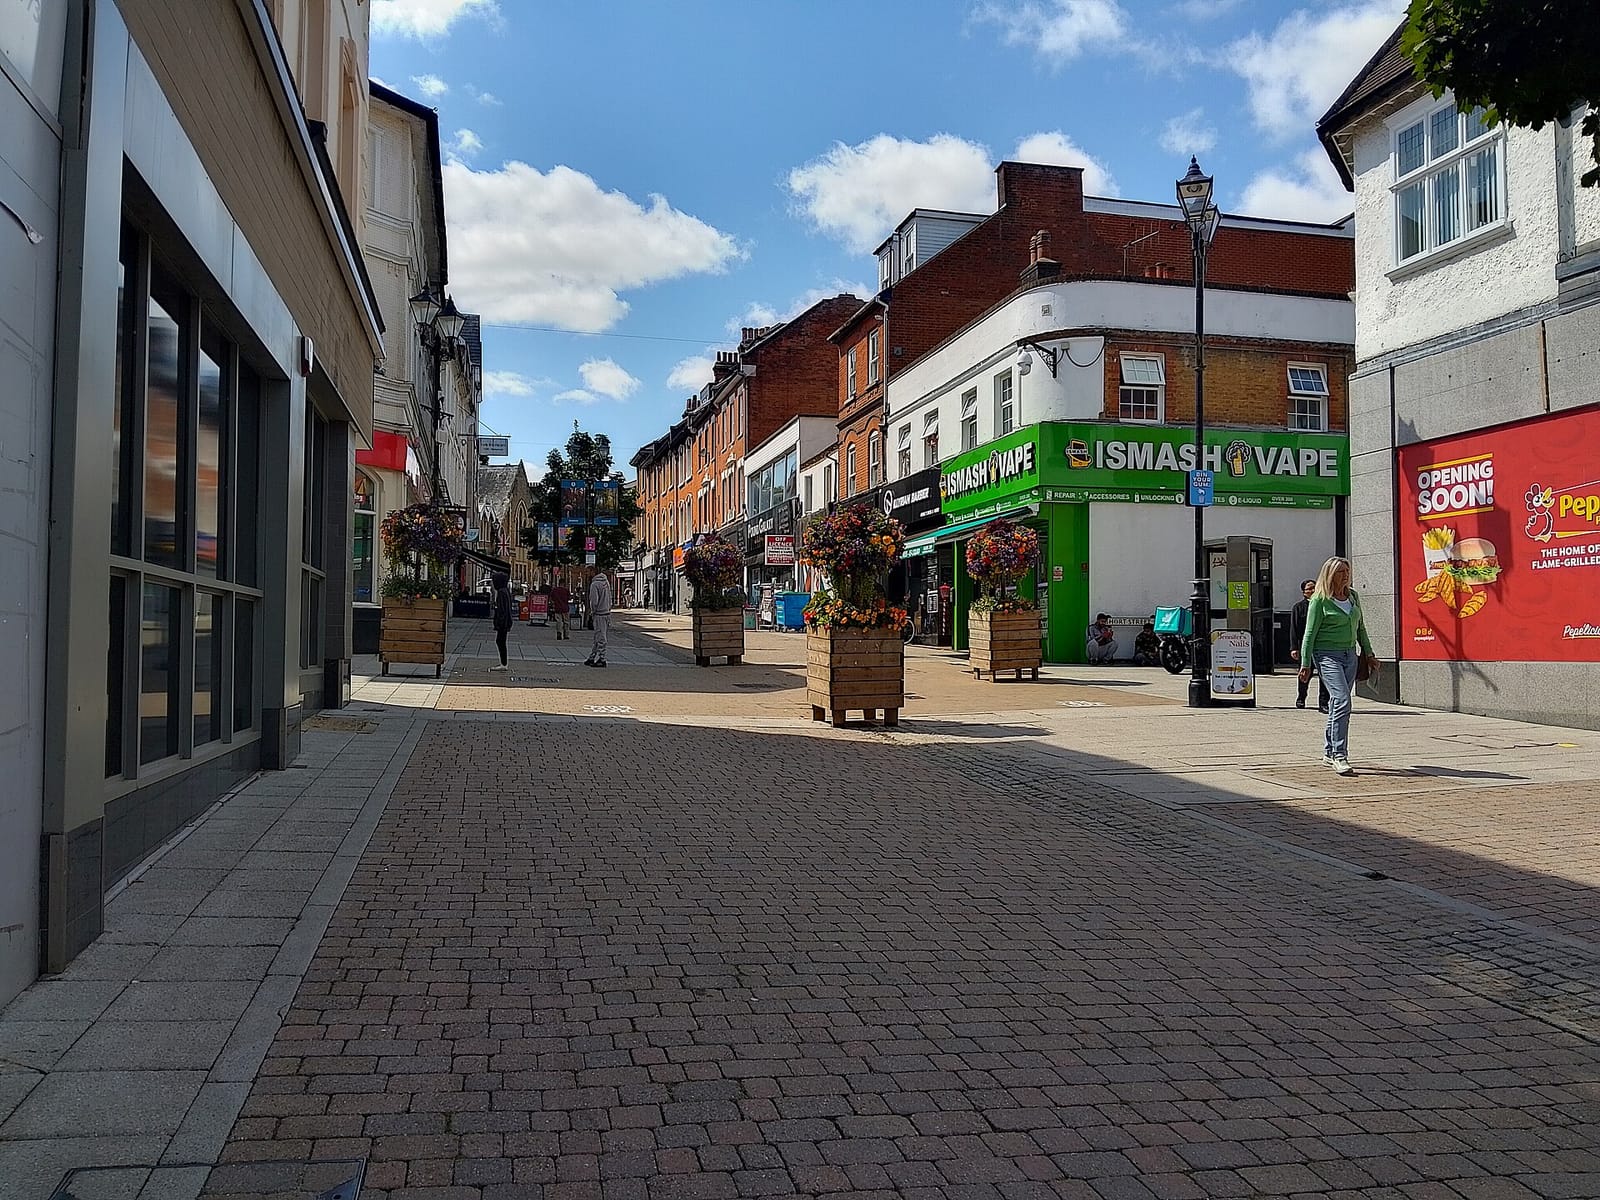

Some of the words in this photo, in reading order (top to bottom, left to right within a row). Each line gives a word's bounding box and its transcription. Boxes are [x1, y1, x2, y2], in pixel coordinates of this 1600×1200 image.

[1096, 440, 1221, 472] ISMASH
[1255, 446, 1338, 476] VAPE
[947, 460, 988, 496] ISMASH
[999, 442, 1033, 478] VAPE
[1418, 461, 1493, 489] OPENING
[1418, 480, 1494, 514] SOON!
[1541, 548, 1558, 558] THE
[1560, 545, 1586, 556] HOME
[1588, 544, 1600, 554] OF
[1531, 556, 1600, 570] FLAME-GRILLED
[1106, 617, 1126, 627] HORT
[1229, 640, 1250, 648] Nails
